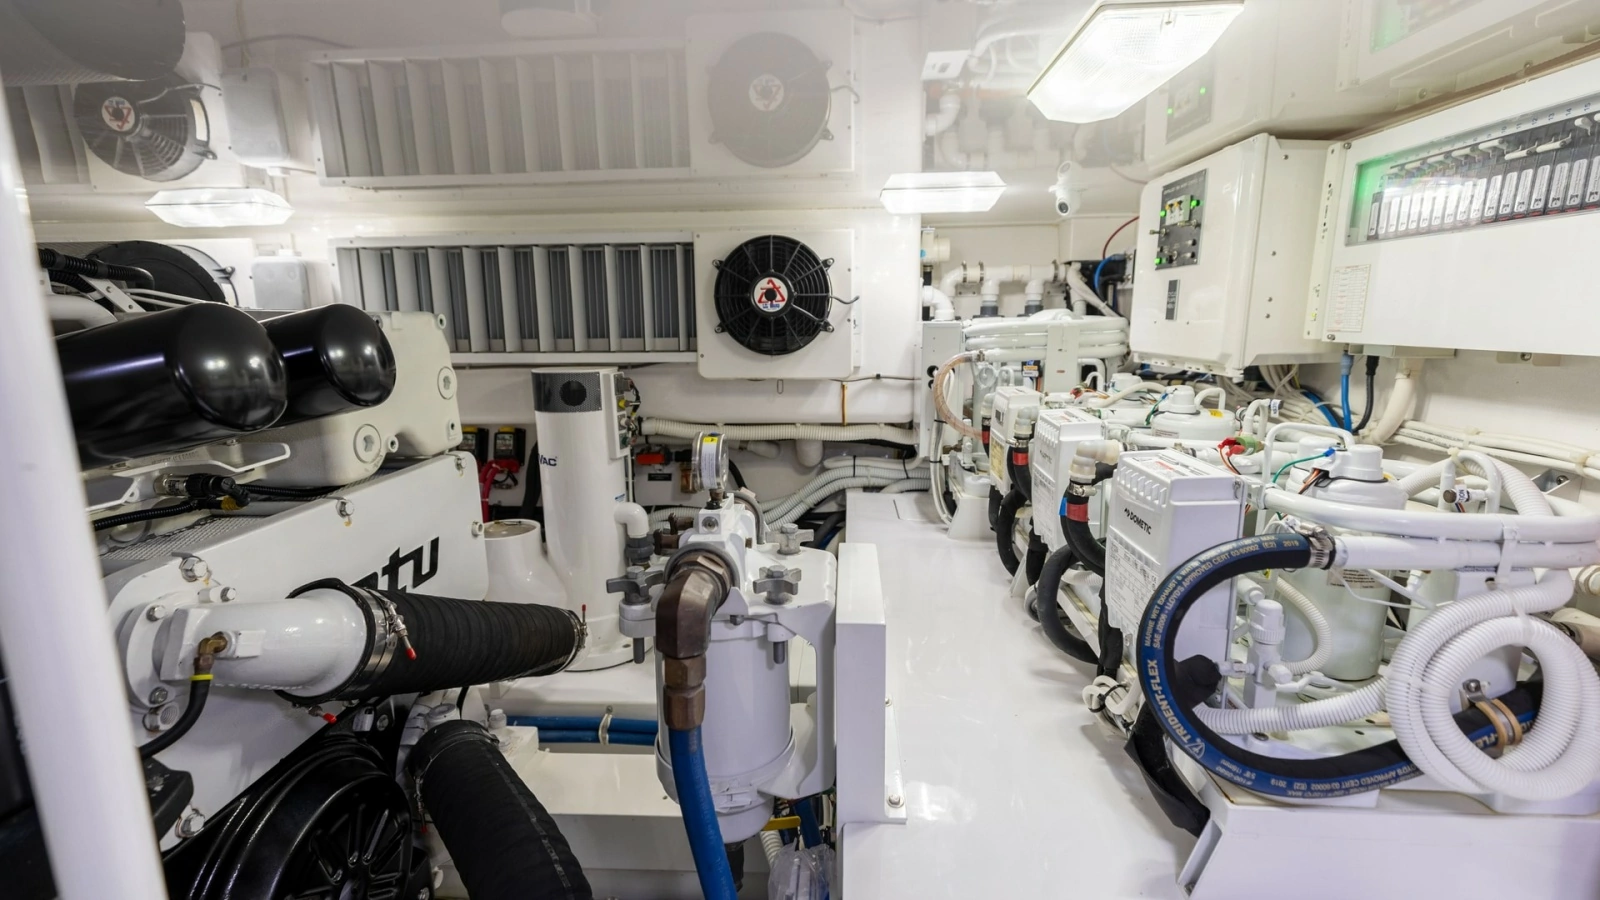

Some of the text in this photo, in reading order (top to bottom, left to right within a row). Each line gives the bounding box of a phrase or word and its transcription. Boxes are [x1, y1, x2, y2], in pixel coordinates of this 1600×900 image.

[1501, 126, 1507, 134] 10
[1532, 118, 1538, 126] 12
[1548, 112, 1555, 121] 13
[1565, 107, 1572, 117] 14
[1584, 102, 1592, 112] 15
[1130, 511, 1152, 535] DOMETIC
[1152, 633, 1161, 649] SAE
[1165, 585, 1185, 611] LLOYD'S
[1182, 560, 1213, 588] APPROVED
[1212, 553, 1231, 565] CERT
[1262, 541, 1277, 550] (E2)
[1144, 620, 1155, 647] MARINE
[1150, 604, 1161, 619] WET
[1157, 579, 1178, 606] EXHAUST
[1147, 659, 1192, 743] TRIDENT-FLEX
[1270, 778, 1287, 788] 2019
[1294, 782, 1307, 791] (E2)
[1340, 779, 1360, 788] CERT
[1361, 769, 1396, 786] APPROVED
